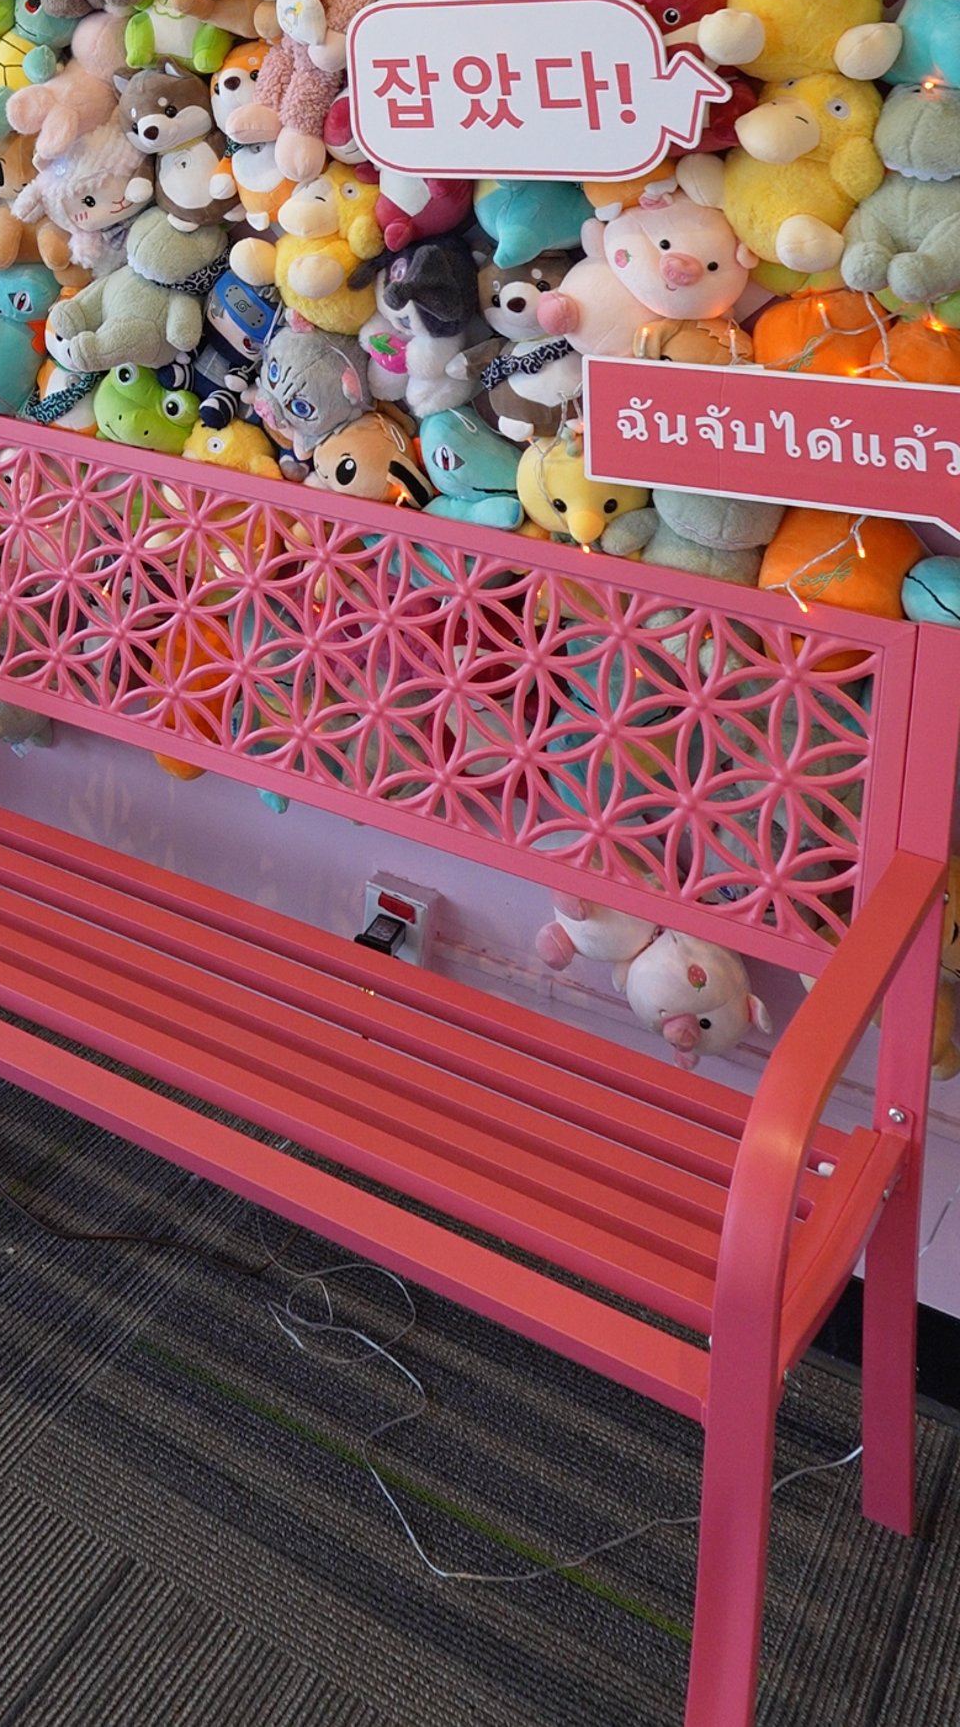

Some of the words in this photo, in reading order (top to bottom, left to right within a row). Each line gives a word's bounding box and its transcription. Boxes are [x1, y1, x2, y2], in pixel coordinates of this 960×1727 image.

[371, 51, 637, 131] 잡았다!
[616, 396, 960, 476] ฉันจับได้แล้ว
